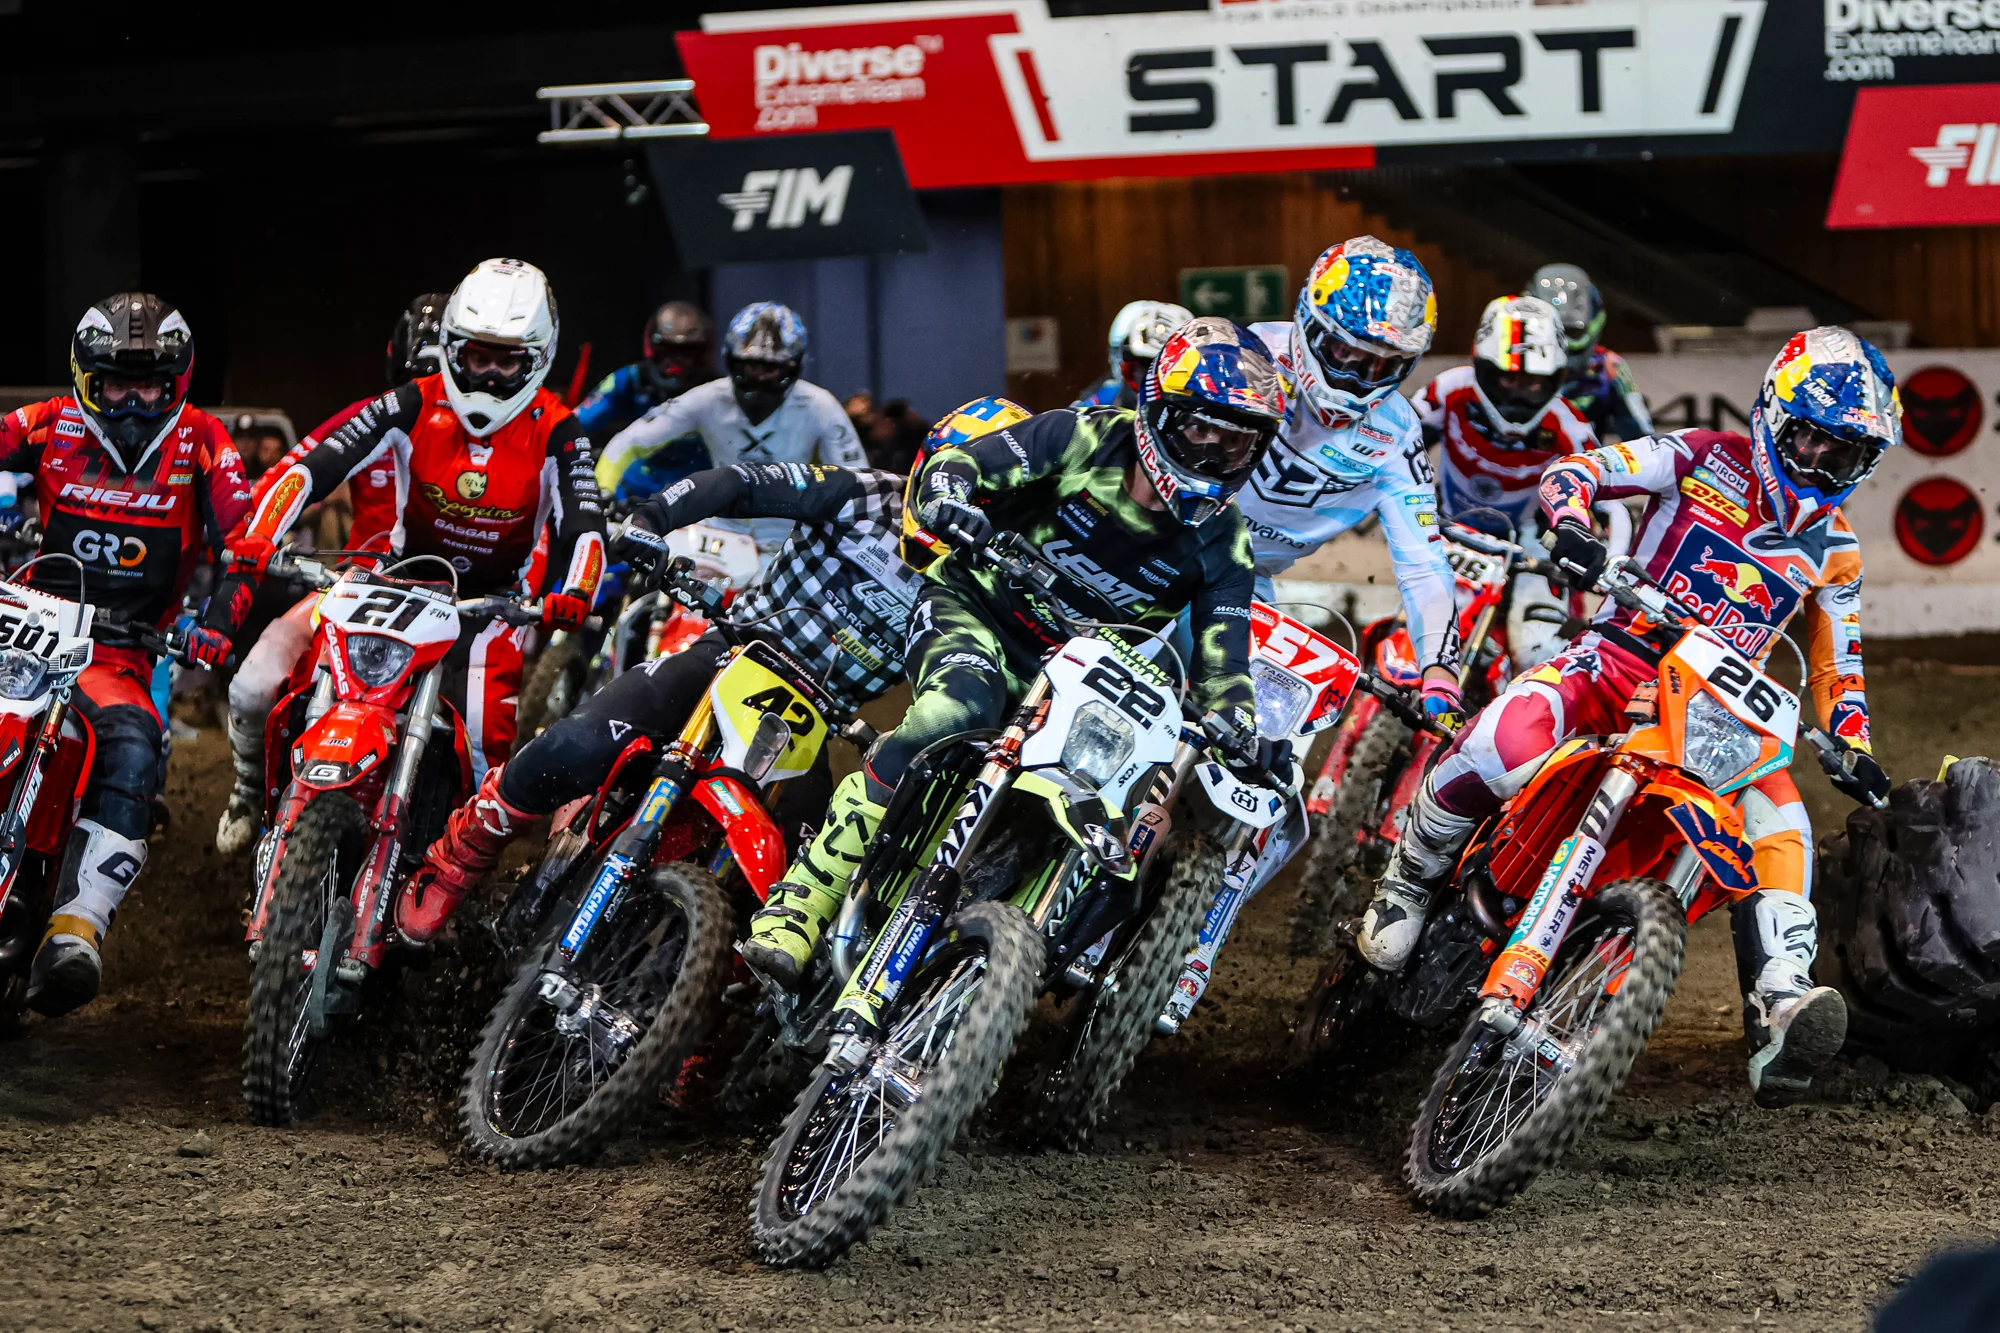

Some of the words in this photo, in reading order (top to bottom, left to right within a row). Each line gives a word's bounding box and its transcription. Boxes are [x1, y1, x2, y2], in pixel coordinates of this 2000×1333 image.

[755, 42, 926, 82] Diverse
[1127, 28, 1637, 132] START
[1823, 55, 1895, 82] .com
[754, 105, 818, 131] .com
[1909, 122, 2000, 188] FI
[719, 164, 854, 232] FIM
[1333, 451, 1375, 475] MOTOREX
[1707, 458, 1746, 490] AIROH
[60, 483, 177, 510] RIEJU
[418, 482, 524, 518] Raposeira
[1690, 483, 1737, 518] DHL
[72, 529, 147, 567] GRO
[434, 518, 501, 541] GASGAS
[1042, 540, 1156, 607] LEATT
[347, 590, 430, 632] 21
[428, 607, 451, 621] FIM
[669, 587, 699, 607] ASV
[825, 589, 866, 631] STARK
[1663, 570, 1729, 627] Red
[1716, 604, 1769, 656] Bull
[325, 622, 349, 695] GASGAS
[1098, 627, 1169, 682] RENTHAL
[1260, 620, 1340, 676] 57
[1082, 655, 1166, 731] 22
[1707, 655, 1782, 723] 26
[3, 748, 21, 768] RIEJU
[1697, 840, 1751, 884] KTM
[565, 871, 615, 947] MICHELIN
[1515, 865, 1562, 935] MOTOREX
[1513, 944, 1548, 967] DHL
[1538, 1041, 1561, 1062] 26
